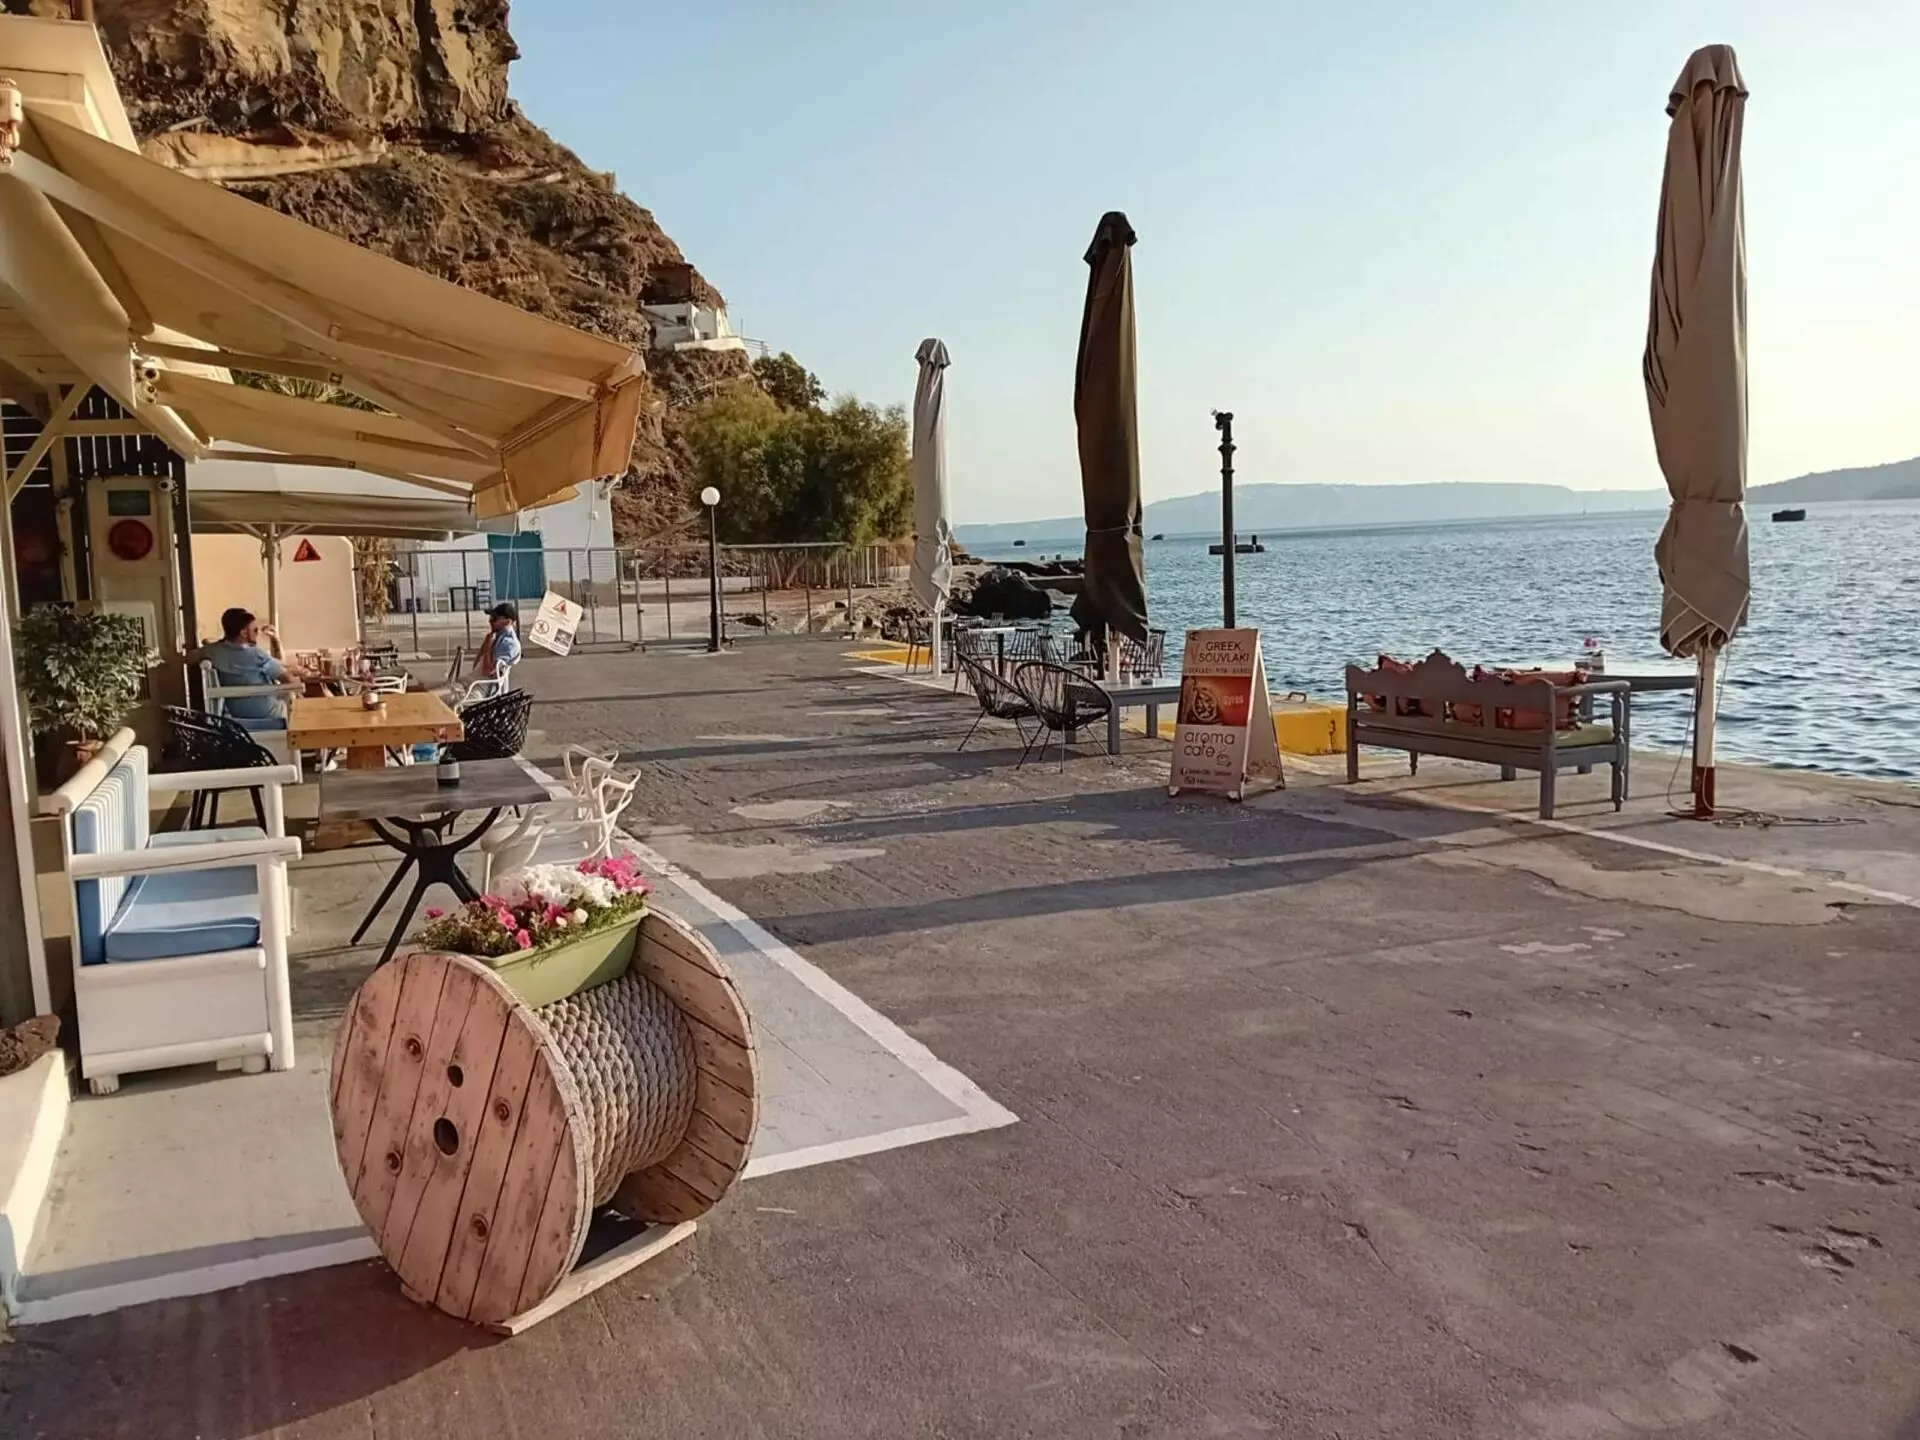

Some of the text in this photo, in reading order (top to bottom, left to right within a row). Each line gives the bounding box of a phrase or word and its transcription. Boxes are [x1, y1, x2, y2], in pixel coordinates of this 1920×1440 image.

[1206, 641, 1242, 651] GREEK
[1199, 652, 1249, 663] SOUVLAKI
[1184, 732, 1235, 745] aroma
